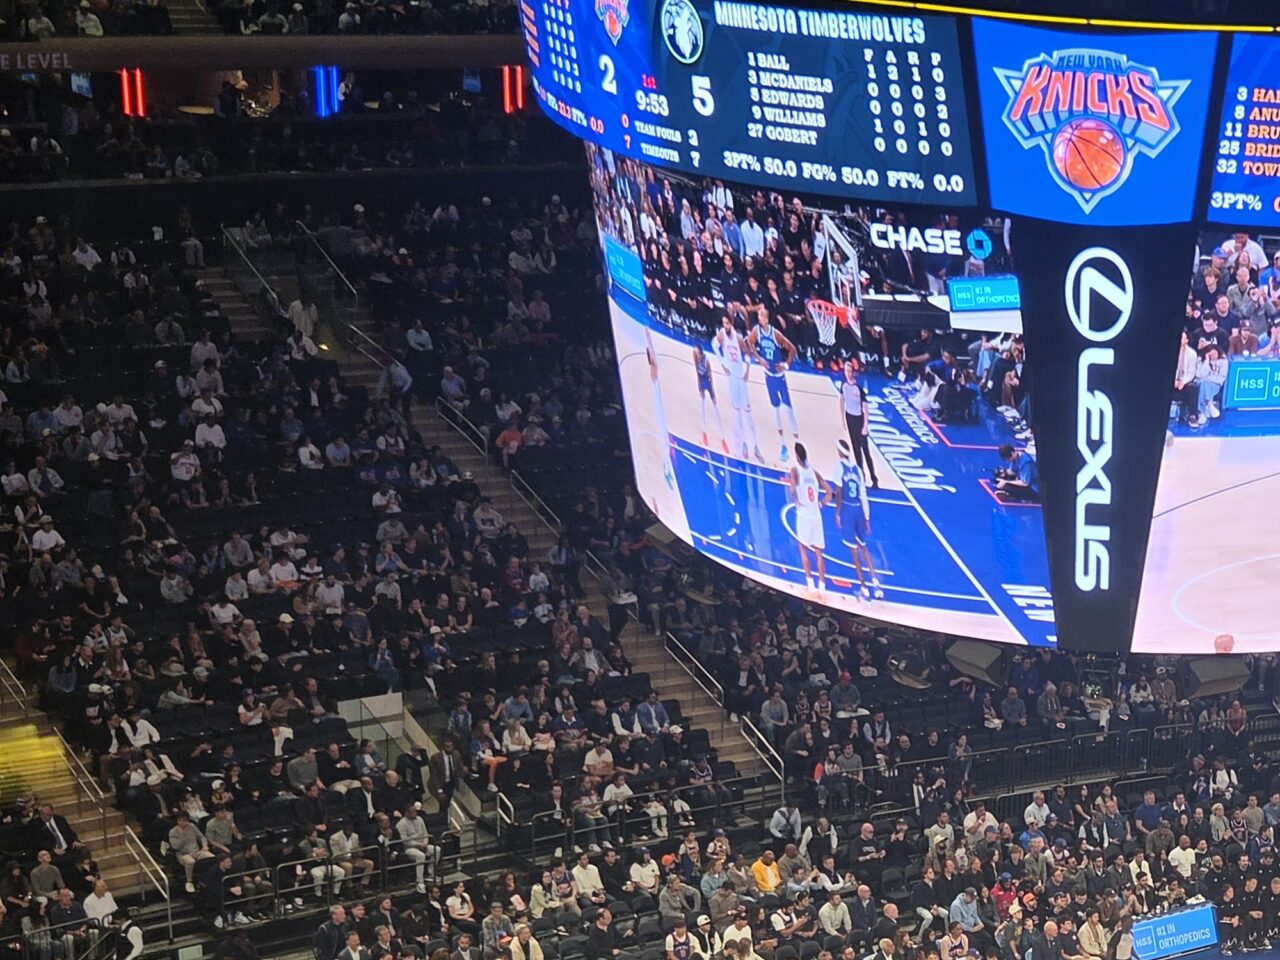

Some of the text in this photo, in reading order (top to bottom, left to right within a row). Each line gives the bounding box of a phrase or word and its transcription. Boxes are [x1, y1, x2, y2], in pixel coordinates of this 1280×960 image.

[714, 1, 926, 44] MINNESOTA TIMBERWOLVES
[16, 53, 72, 69] LEVEL
[748, 52, 789, 71] 1 BALL
[1057, 54, 1123, 72] NEW YORK
[599, 54, 617, 95] 2
[641, 74, 657, 89] 1st
[748, 70, 833, 93] 3 MCDANIELS
[635, 89, 669, 117] 9:53
[691, 75, 715, 117] 5
[751, 88, 824, 109] 5 EDWARDS
[1010, 64, 1171, 132] KNICKS
[1236, 87, 1248, 102] 3
[752, 105, 826, 127] 9 WILLIAMS
[1234, 105, 1245, 120] 8
[621, 114, 698, 147] 0 TEAM FOULS 2
[747, 123, 817, 145] 27 GOBERT
[1225, 122, 1243, 137] 11
[624, 136, 700, 168] 7 TIMEOUTS 7
[1219, 140, 1240, 156] 25
[723, 151, 963, 192] 3PT% 50.0 FG% 50.0 FT% 0.0
[1216, 159, 1237, 174] 32
[1210, 191, 1262, 211] 3PT%
[869, 223, 963, 256] CHASE
[1240, 379, 1264, 389] HSS
[1075, 346, 1114, 592] LEXUS
[1159, 928, 1210, 950] ORTHOPEDICS
[1167, 923, 1175, 934] IN
